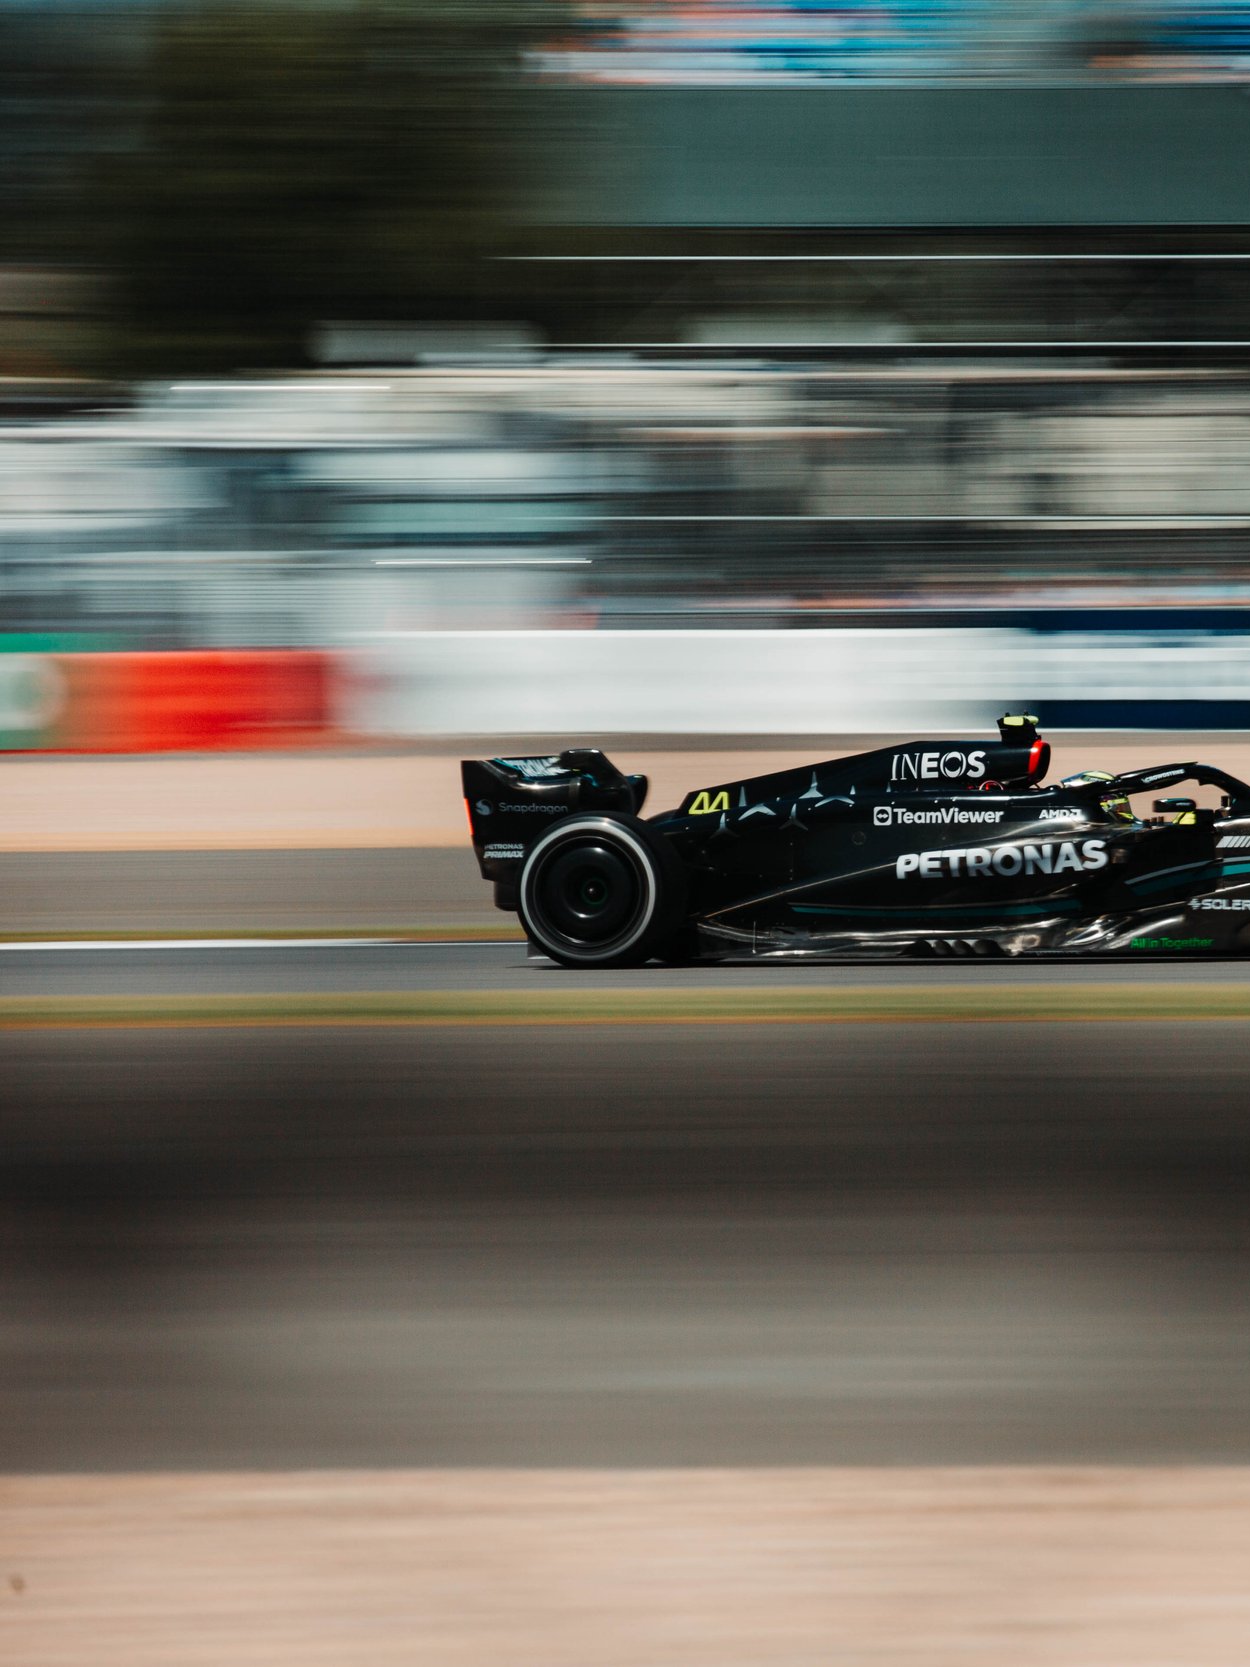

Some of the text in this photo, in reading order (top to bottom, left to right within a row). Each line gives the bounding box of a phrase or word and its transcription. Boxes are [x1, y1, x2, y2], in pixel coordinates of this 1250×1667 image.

[890, 750, 986, 781] INEOS
[499, 802, 568, 815] Snapdragon
[688, 791, 730, 815] 44
[893, 806, 1004, 824] TeamViewer
[1038, 808, 1069, 819] AMD
[896, 839, 1109, 879] PETRONAS
[1160, 937, 1214, 950] Together
